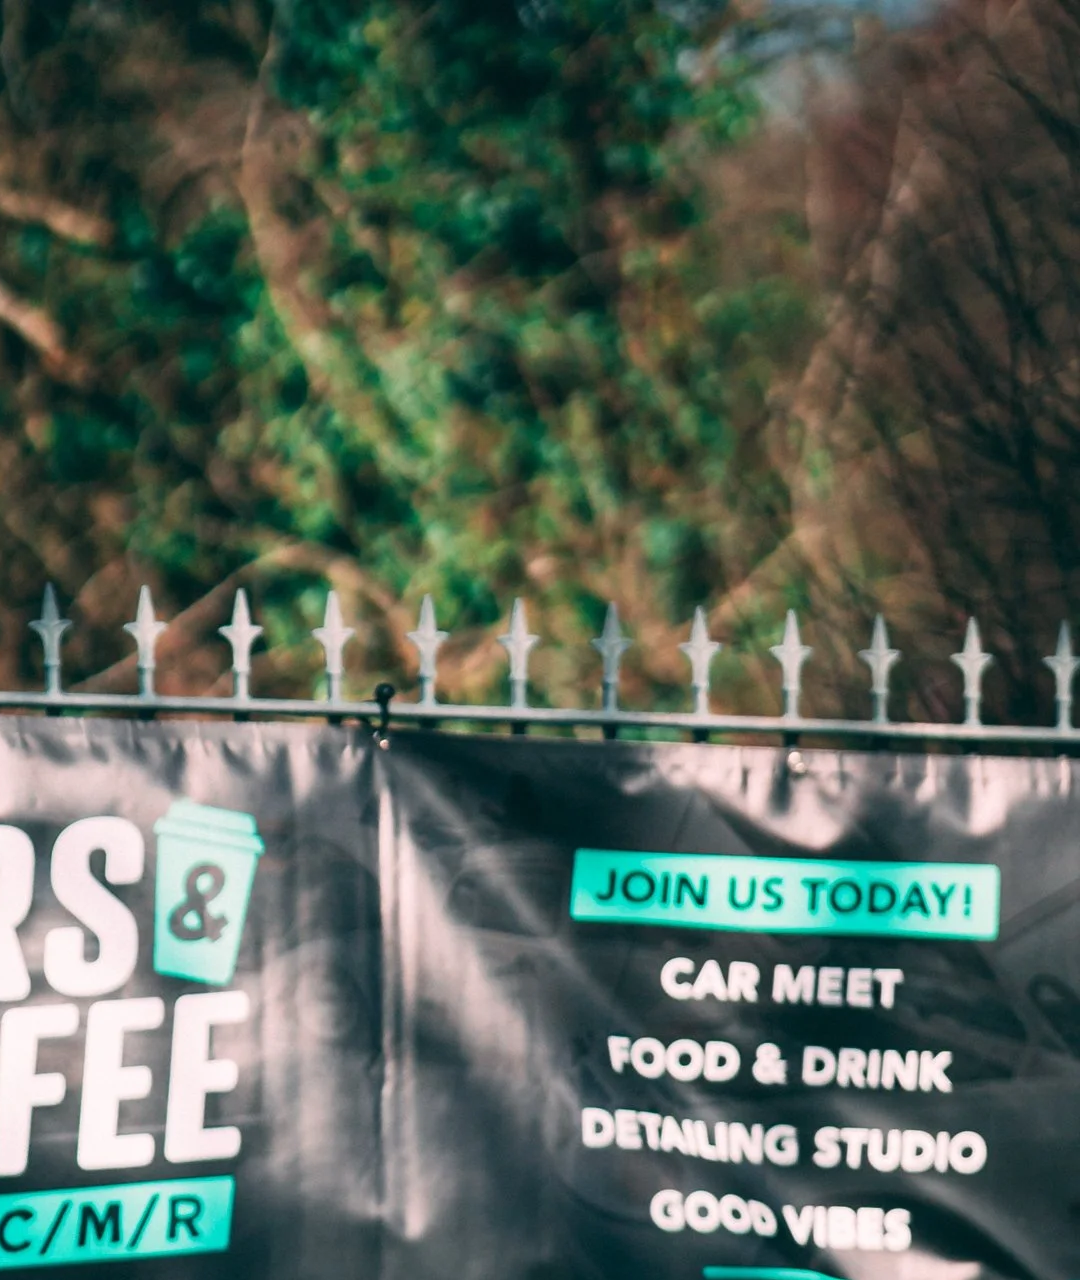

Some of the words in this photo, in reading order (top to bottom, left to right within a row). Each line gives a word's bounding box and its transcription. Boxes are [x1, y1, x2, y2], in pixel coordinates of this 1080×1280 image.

[169, 864, 229, 942] &
[596, 868, 709, 908] JOIN
[727, 876, 784, 911] US
[802, 877, 973, 918] TODAY!
[660, 957, 761, 1002] CAR
[772, 963, 905, 1008] MEET
[607, 1035, 741, 1082] FOOD
[752, 1042, 787, 1085] &
[801, 1046, 954, 1092] DRINK
[581, 1107, 799, 1166] DETAILING
[812, 1127, 988, 1175] STUDIO
[650, 1189, 778, 1238] GOOD
[782, 1204, 913, 1252] VIBES
